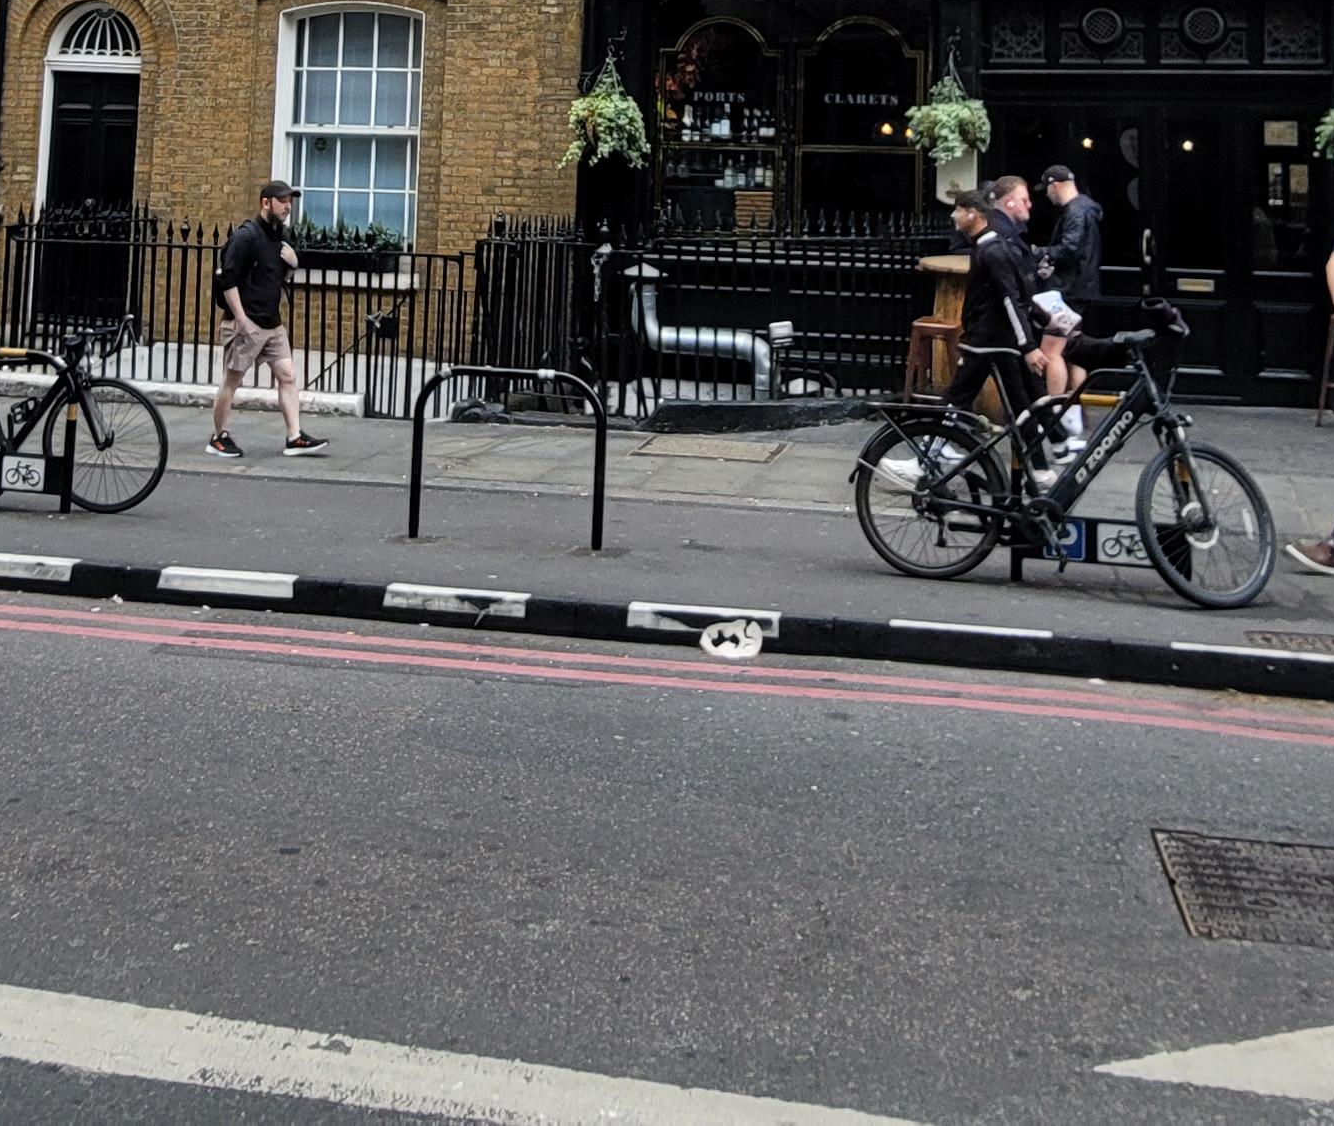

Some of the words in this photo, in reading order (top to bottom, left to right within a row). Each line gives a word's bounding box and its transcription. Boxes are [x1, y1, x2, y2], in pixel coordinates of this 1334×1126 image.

[693, 91, 746, 103] PORTS
[823, 92, 899, 106] CLARETS
[1085, 410, 1135, 471] zoomo
